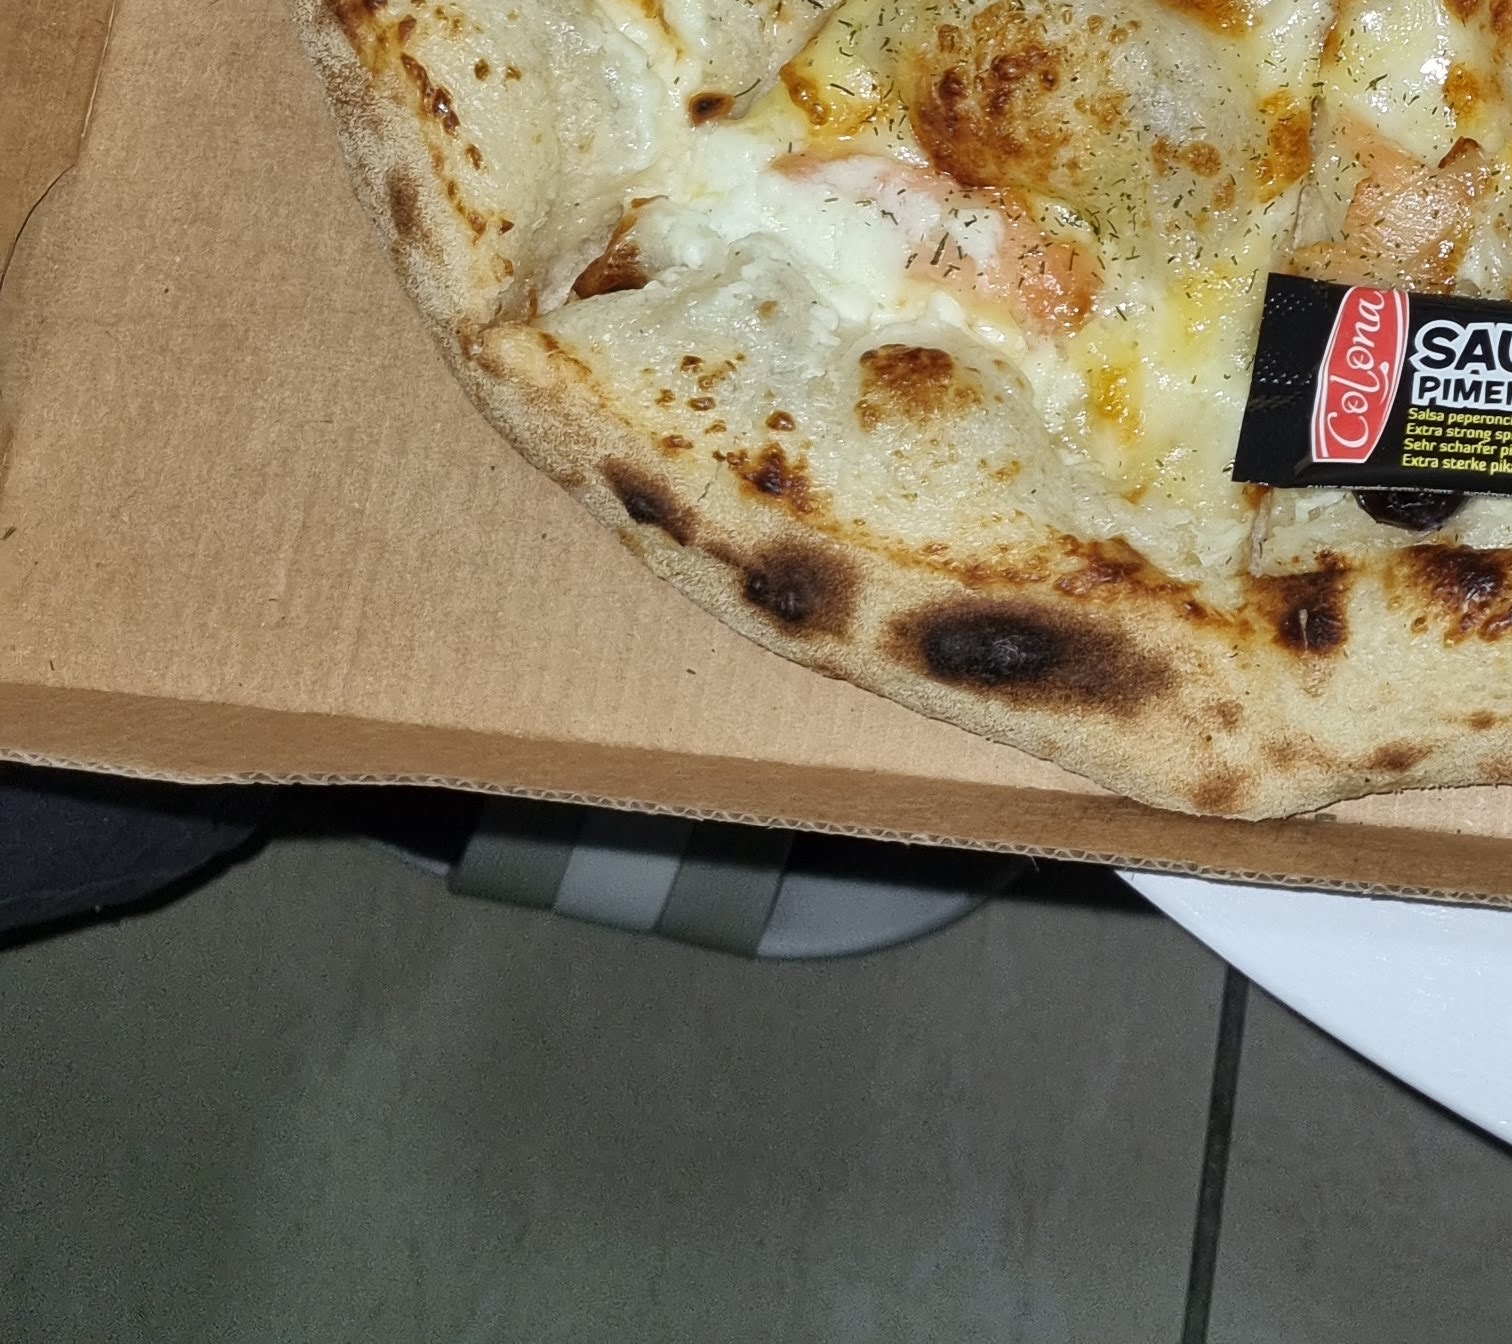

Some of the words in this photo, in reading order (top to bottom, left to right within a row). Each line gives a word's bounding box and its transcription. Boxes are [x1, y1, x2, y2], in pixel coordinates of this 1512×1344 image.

[1327, 289, 1387, 449] Colona
[1408, 407, 1445, 422] Salsa
[1406, 422, 1443, 437] Extra
[1445, 425, 1491, 443] strong
[1403, 437, 1437, 452] Sehr
[1439, 440, 1498, 455] scharfer
[1402, 453, 1439, 468] Extra
[1442, 456, 1487, 472] sterke
